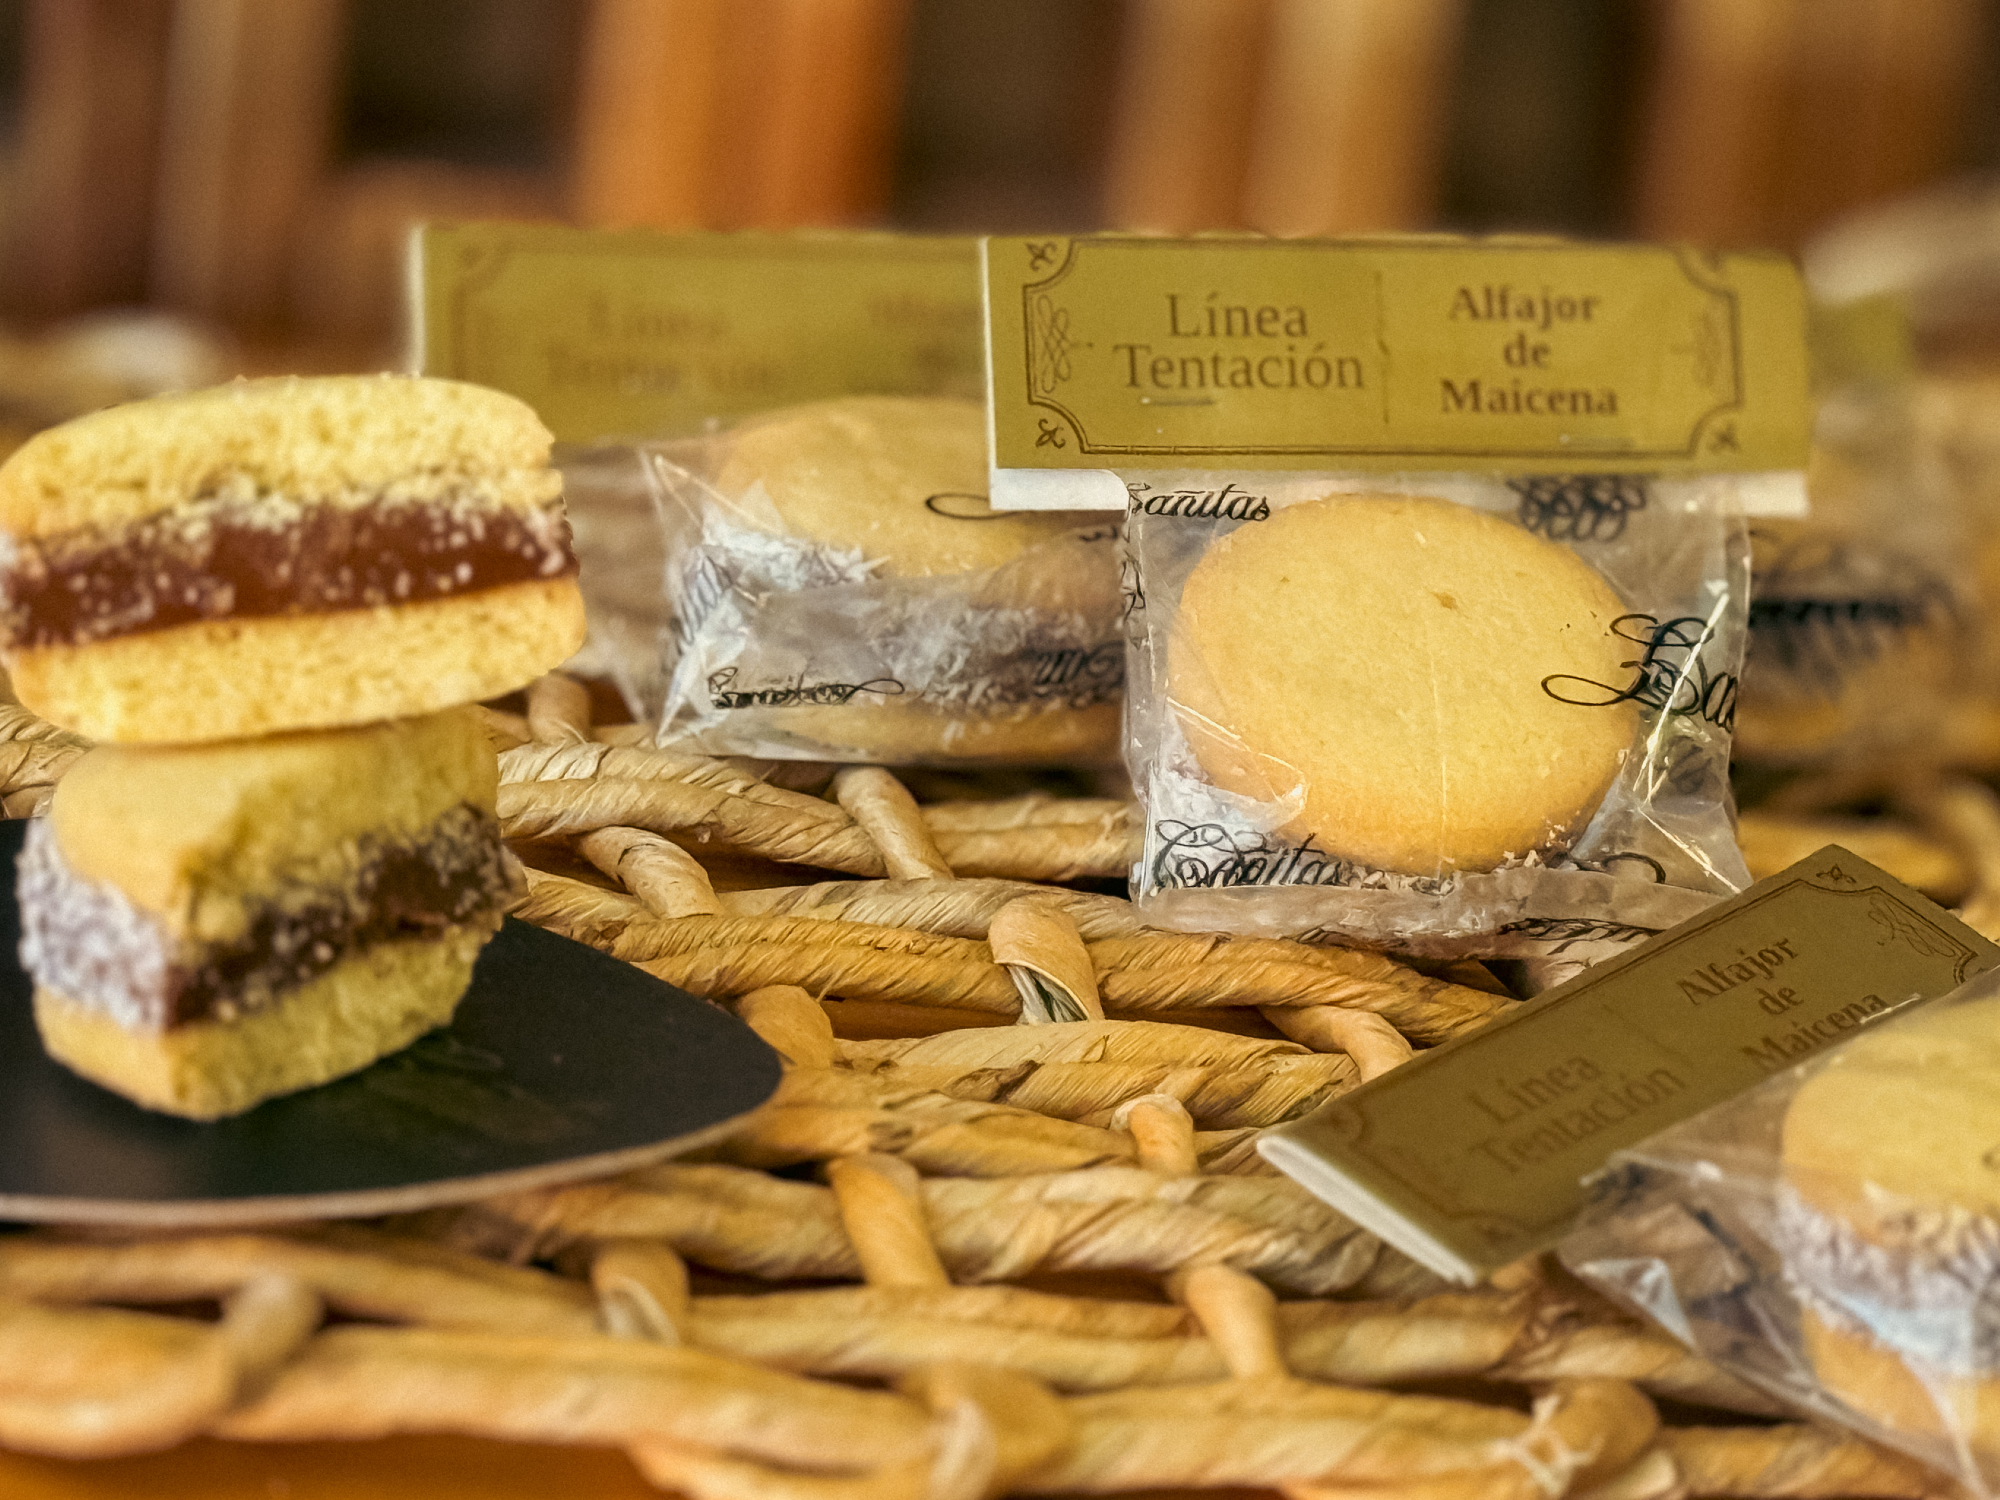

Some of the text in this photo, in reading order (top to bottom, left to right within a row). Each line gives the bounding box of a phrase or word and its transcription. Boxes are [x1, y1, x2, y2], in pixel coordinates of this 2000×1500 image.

[1166, 291, 1309, 340] Línea
[1447, 285, 1601, 331] Alfajor
[1112, 340, 1365, 391] Tentación
[1503, 331, 1551, 368] de
[1438, 376, 1619, 417] Maicena
[1676, 938, 1799, 1006] Alfajor
[1755, 985, 1804, 1016] de
[1740, 993, 1890, 1068] Maicena
